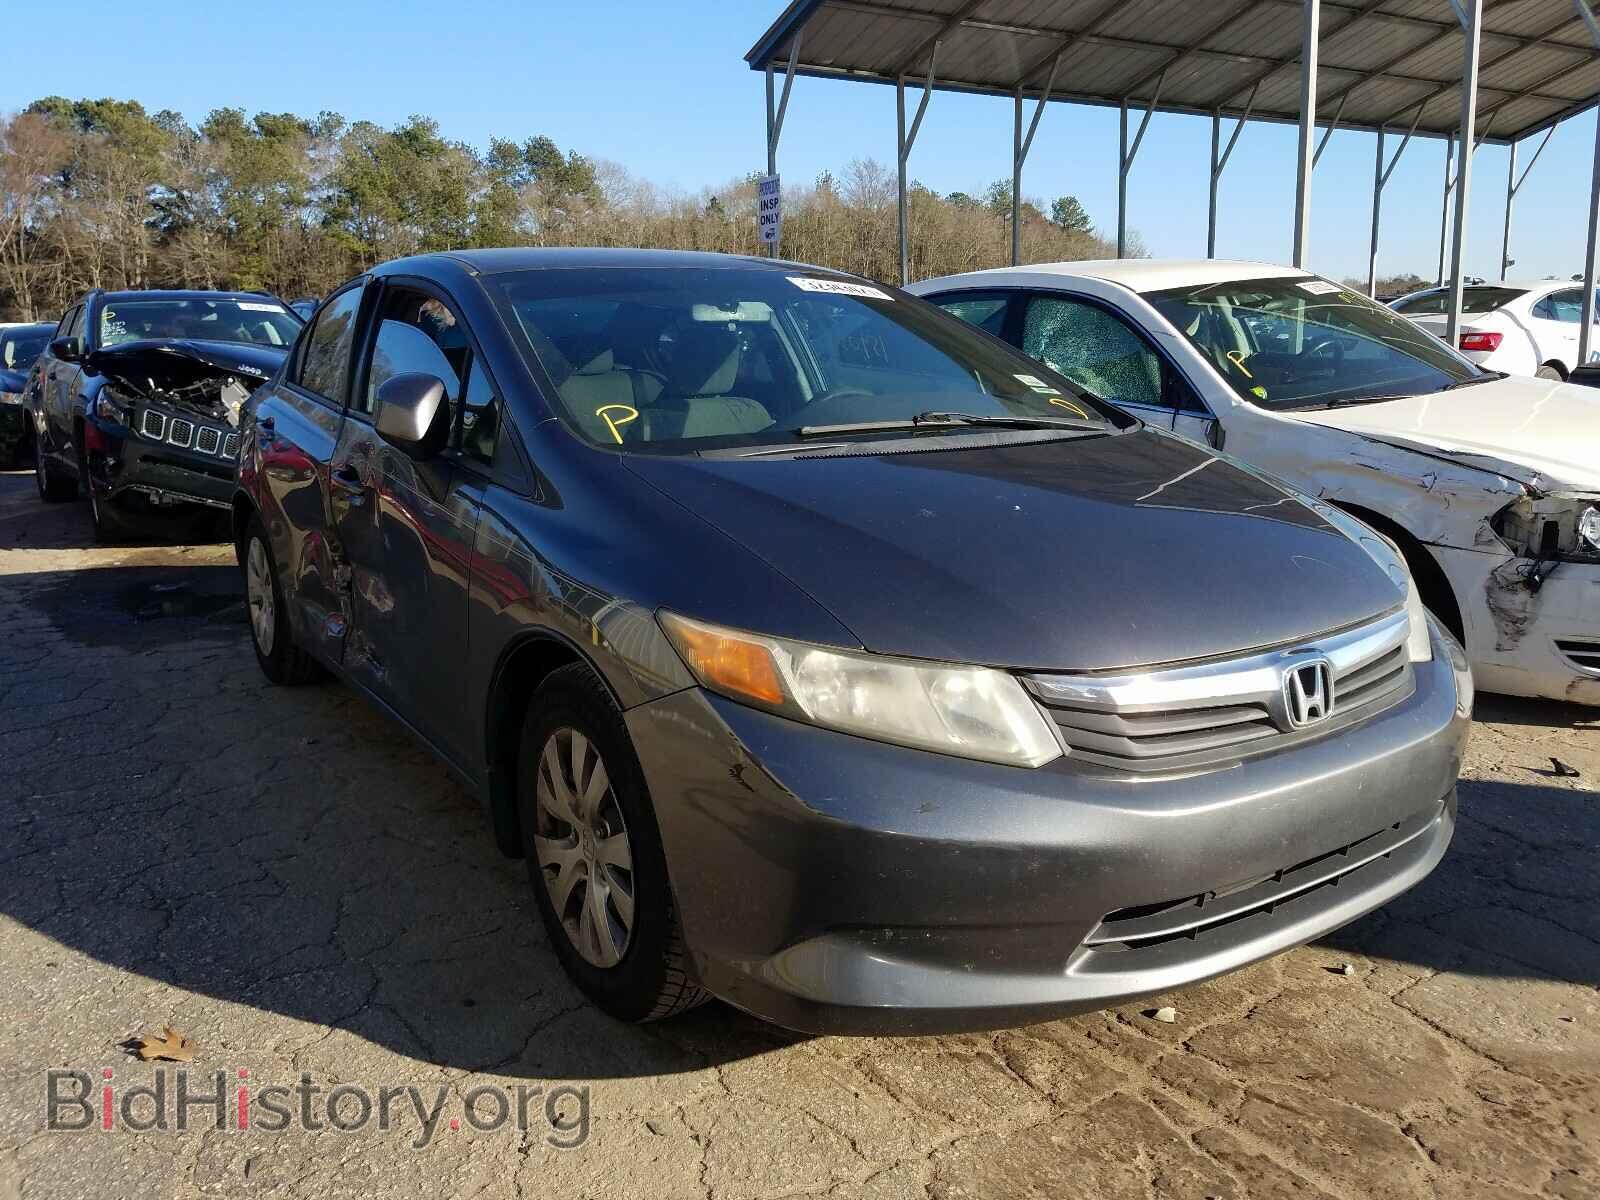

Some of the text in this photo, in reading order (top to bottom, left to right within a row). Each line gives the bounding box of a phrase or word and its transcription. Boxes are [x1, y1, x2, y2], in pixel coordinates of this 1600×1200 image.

[760, 197, 779, 211] INSP
[760, 212, 779, 226] ONLY
[1226, 350, 1253, 378] P
[595, 404, 639, 445] P
